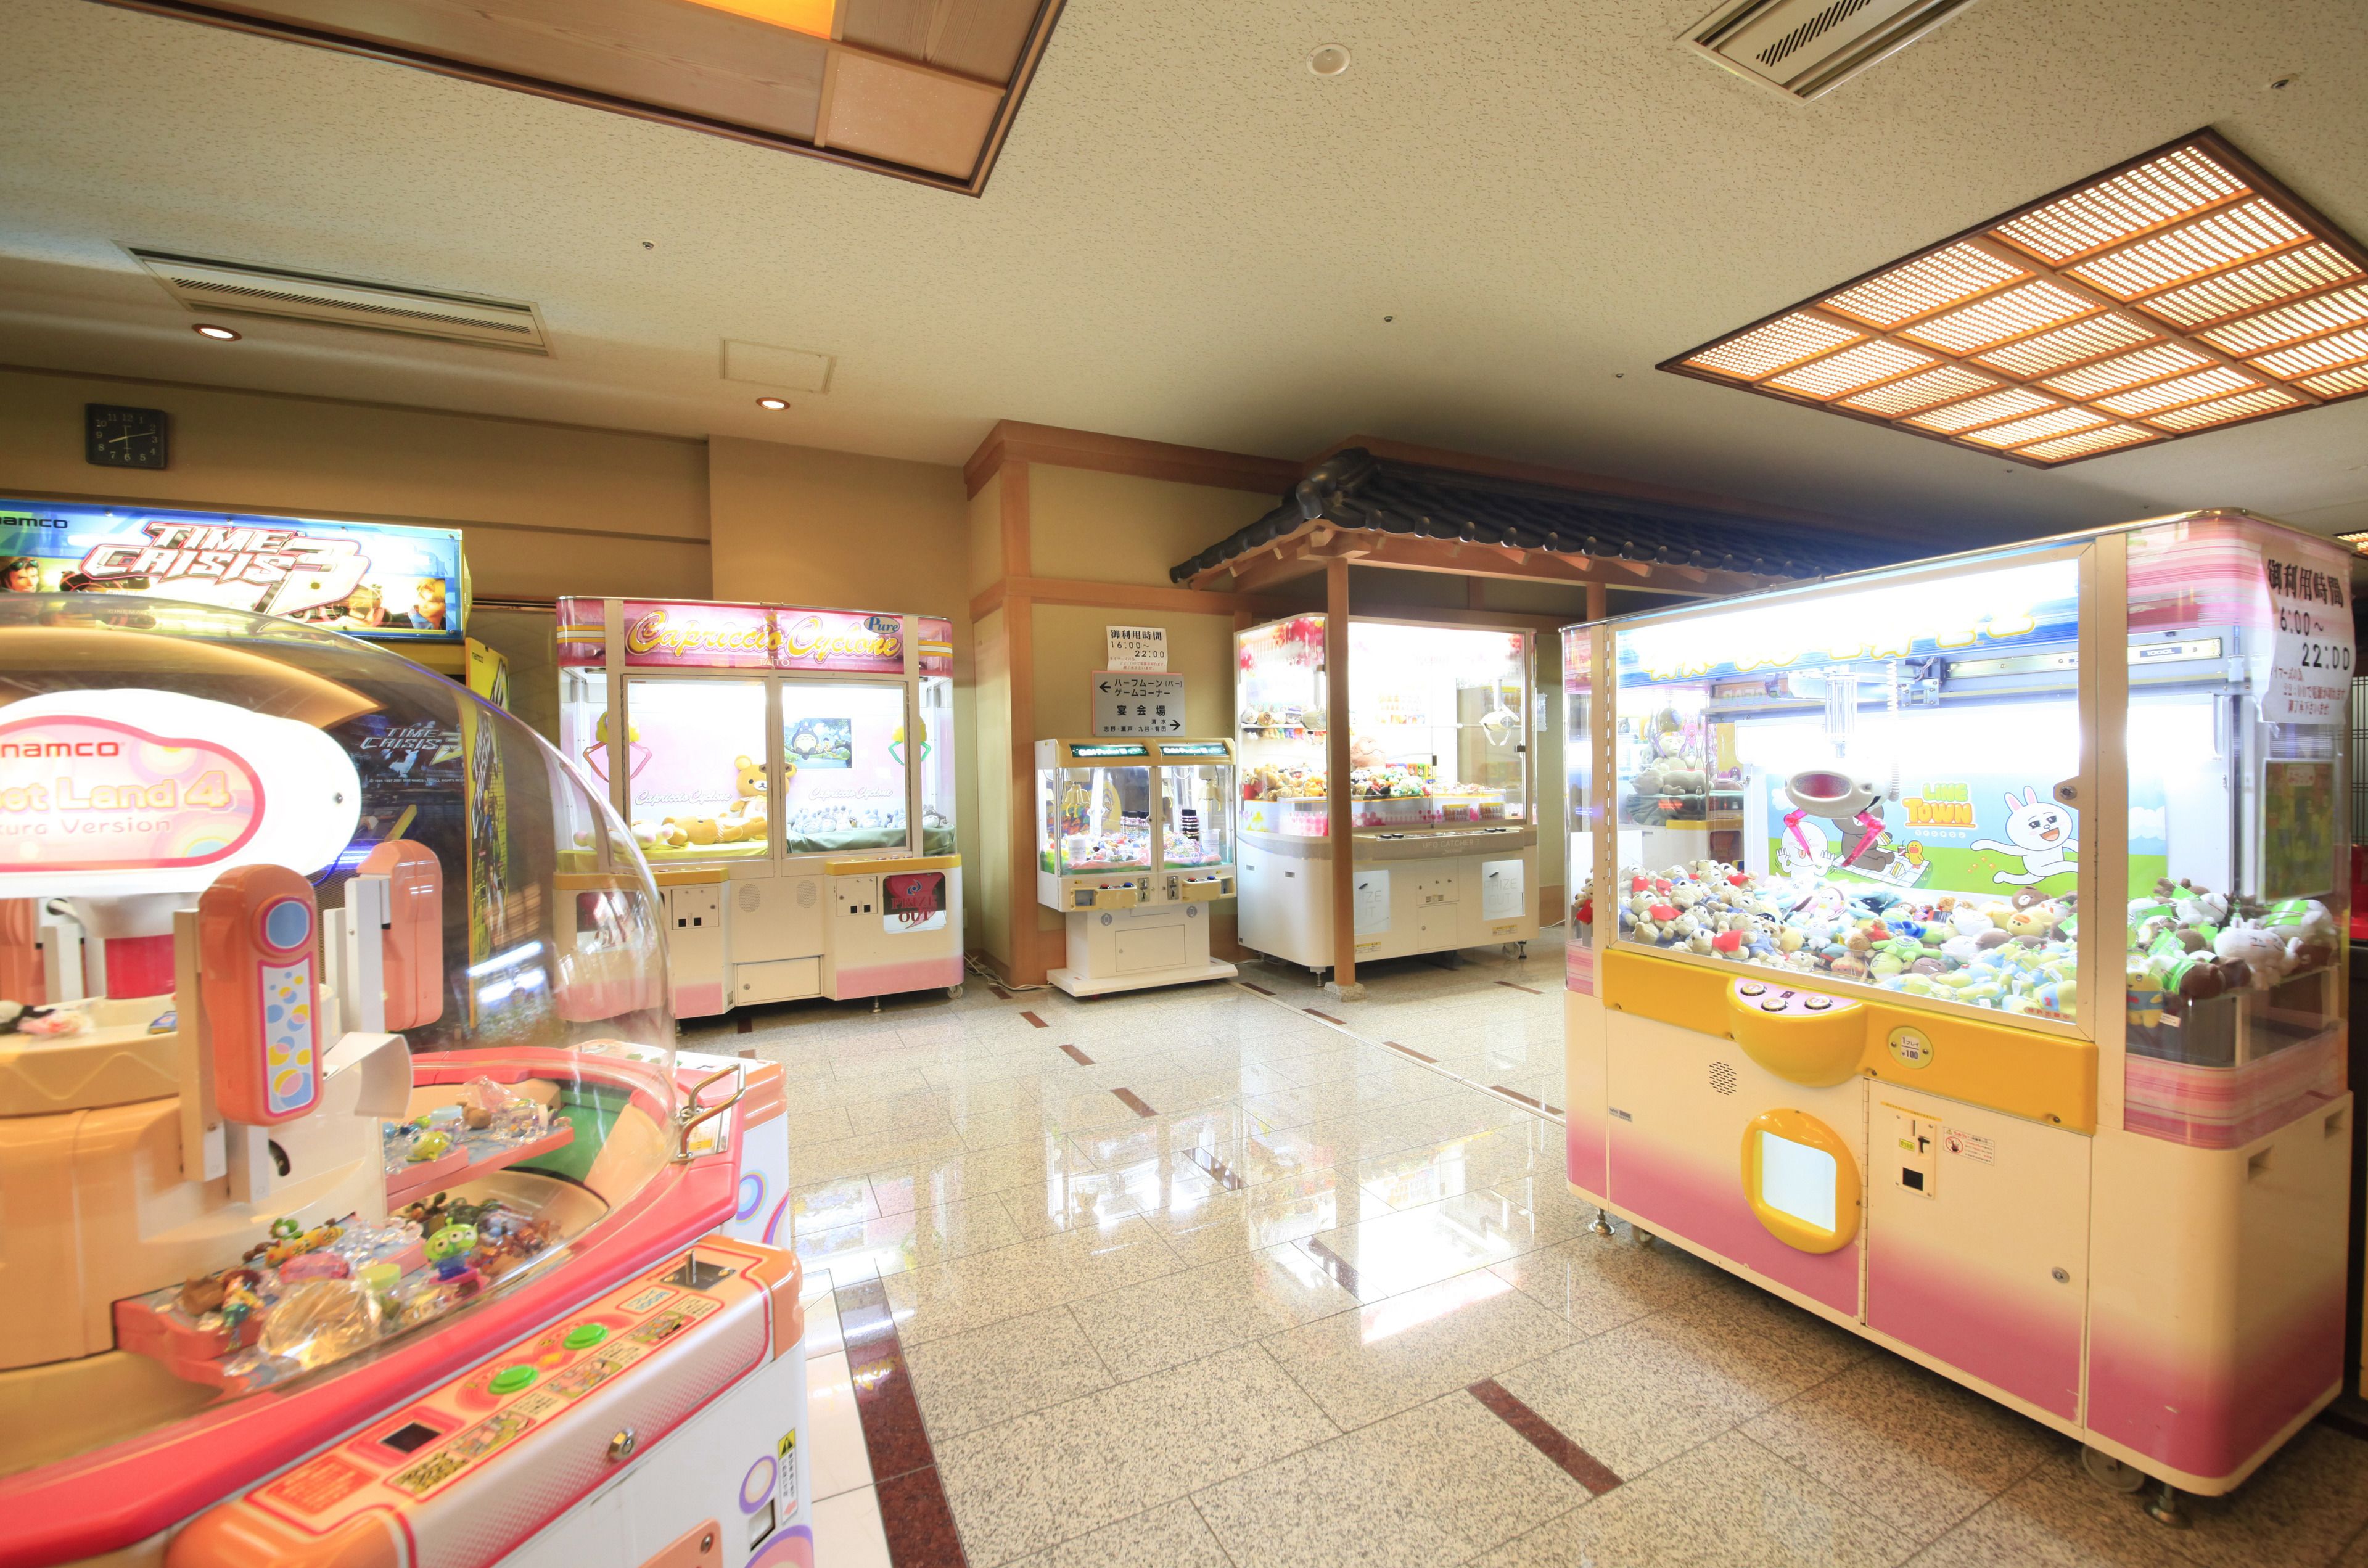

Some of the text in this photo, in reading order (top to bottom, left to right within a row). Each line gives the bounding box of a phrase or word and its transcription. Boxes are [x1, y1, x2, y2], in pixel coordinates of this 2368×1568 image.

[0, 517, 68, 528] amco
[149, 523, 291, 553] TIME
[83, 537, 370, 615] CRISIS 3
[2267, 559, 2344, 608] 御利用時間
[867, 617, 899, 633] Pure
[627, 609, 902, 663] Capriccio Cyclone
[1111, 630, 1162, 641] 御利用時間
[1135, 650, 1165, 658] 22:00
[2302, 642, 2350, 671] 22:00
[1114, 689, 1170, 697] ゲームコーナー
[1117, 705, 1166, 716] 宴会場
[386, 728, 440, 738] TIME
[2, 742, 119, 757] namco
[360, 737, 443, 750] CRISIS
[0, 771, 231, 811] et Land 4
[635, 789, 732, 806] Capriccio Cyclone
[808, 787, 855, 801] Capriccio
[1923, 783, 1968, 802] LINE
[1902, 798, 1972, 824] TOWN
[62, 817, 170, 834] Version
[1441, 839, 1474, 848] CATCHER
[891, 895, 938, 909] PRIZE
[1362, 890, 1382, 903] IZE
[1489, 893, 1511, 905] OUT
[898, 910, 930, 922] OUT
[1902, 1036, 1920, 1048] 1プレイ
